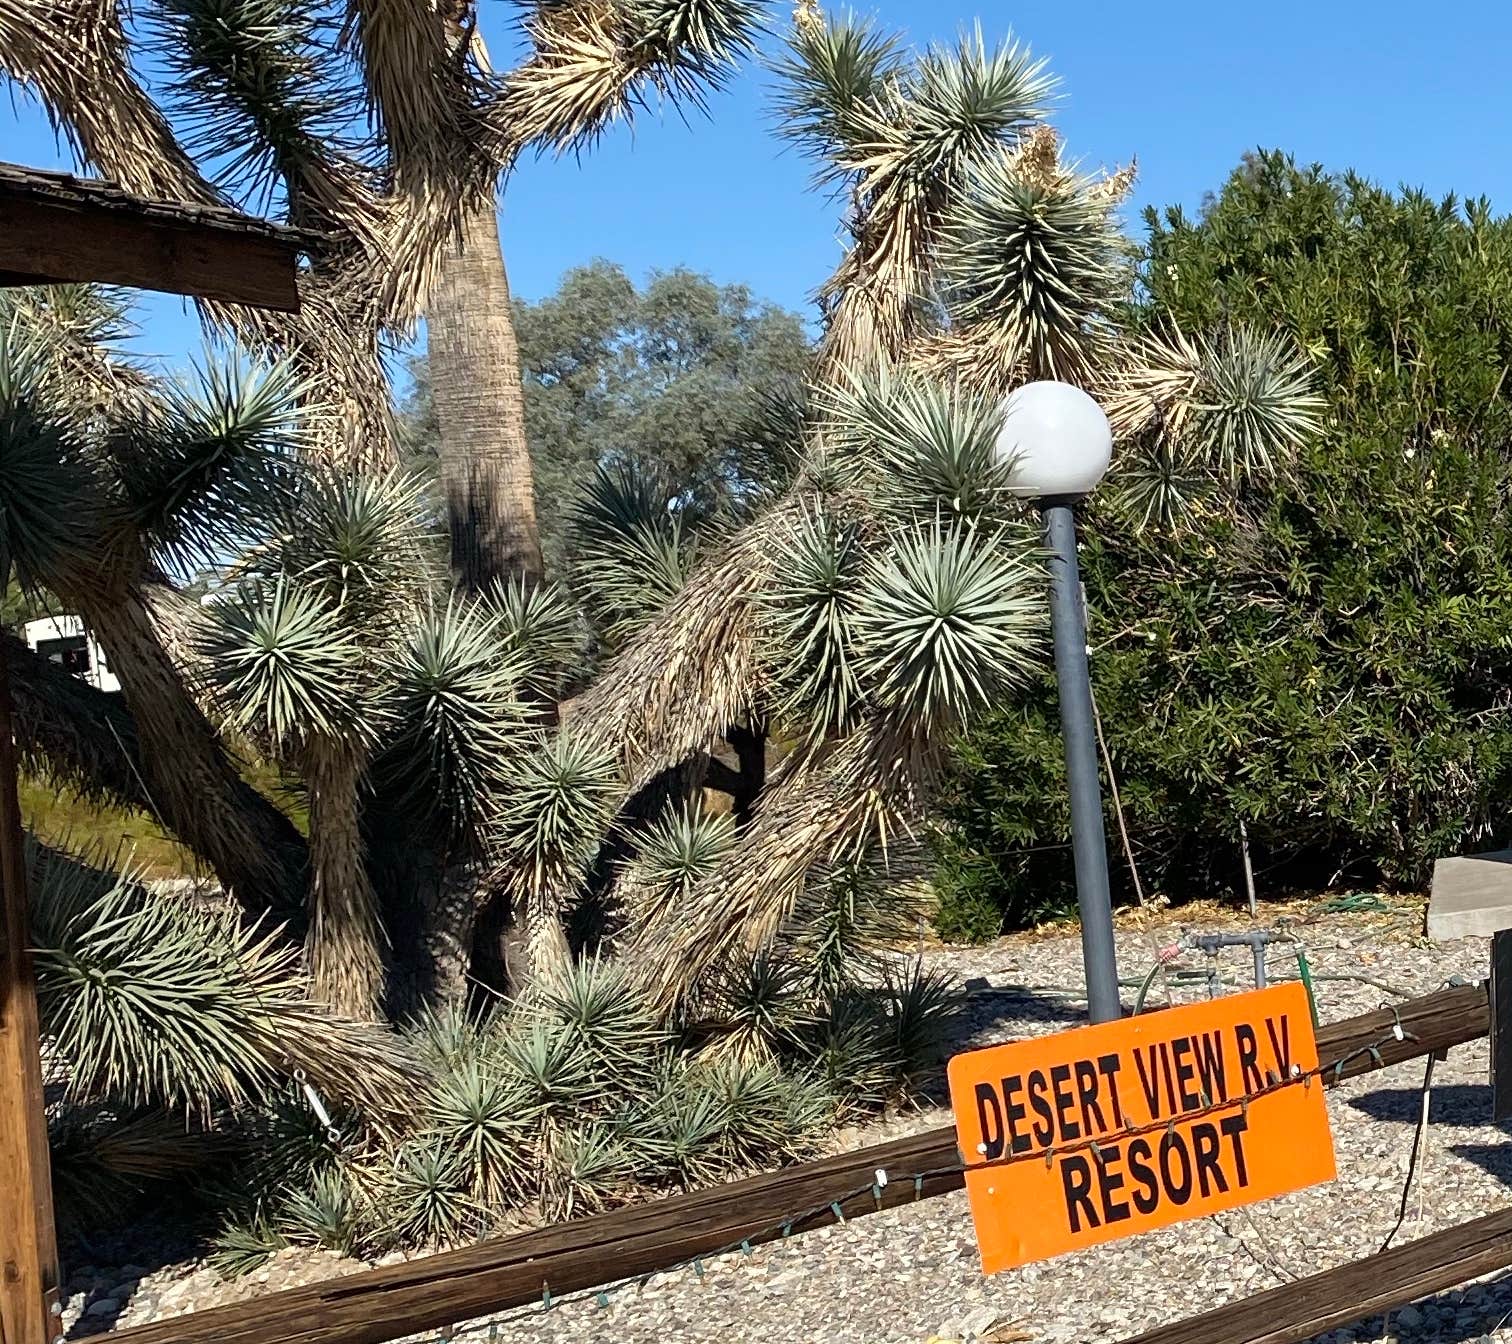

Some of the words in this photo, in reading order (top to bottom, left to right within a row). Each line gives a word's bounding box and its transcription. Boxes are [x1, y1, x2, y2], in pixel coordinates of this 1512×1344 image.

[974, 1053, 1123, 1160] DESERT
[1132, 1030, 1227, 1120] VIEW
[1060, 1114, 1249, 1234] RESORT
